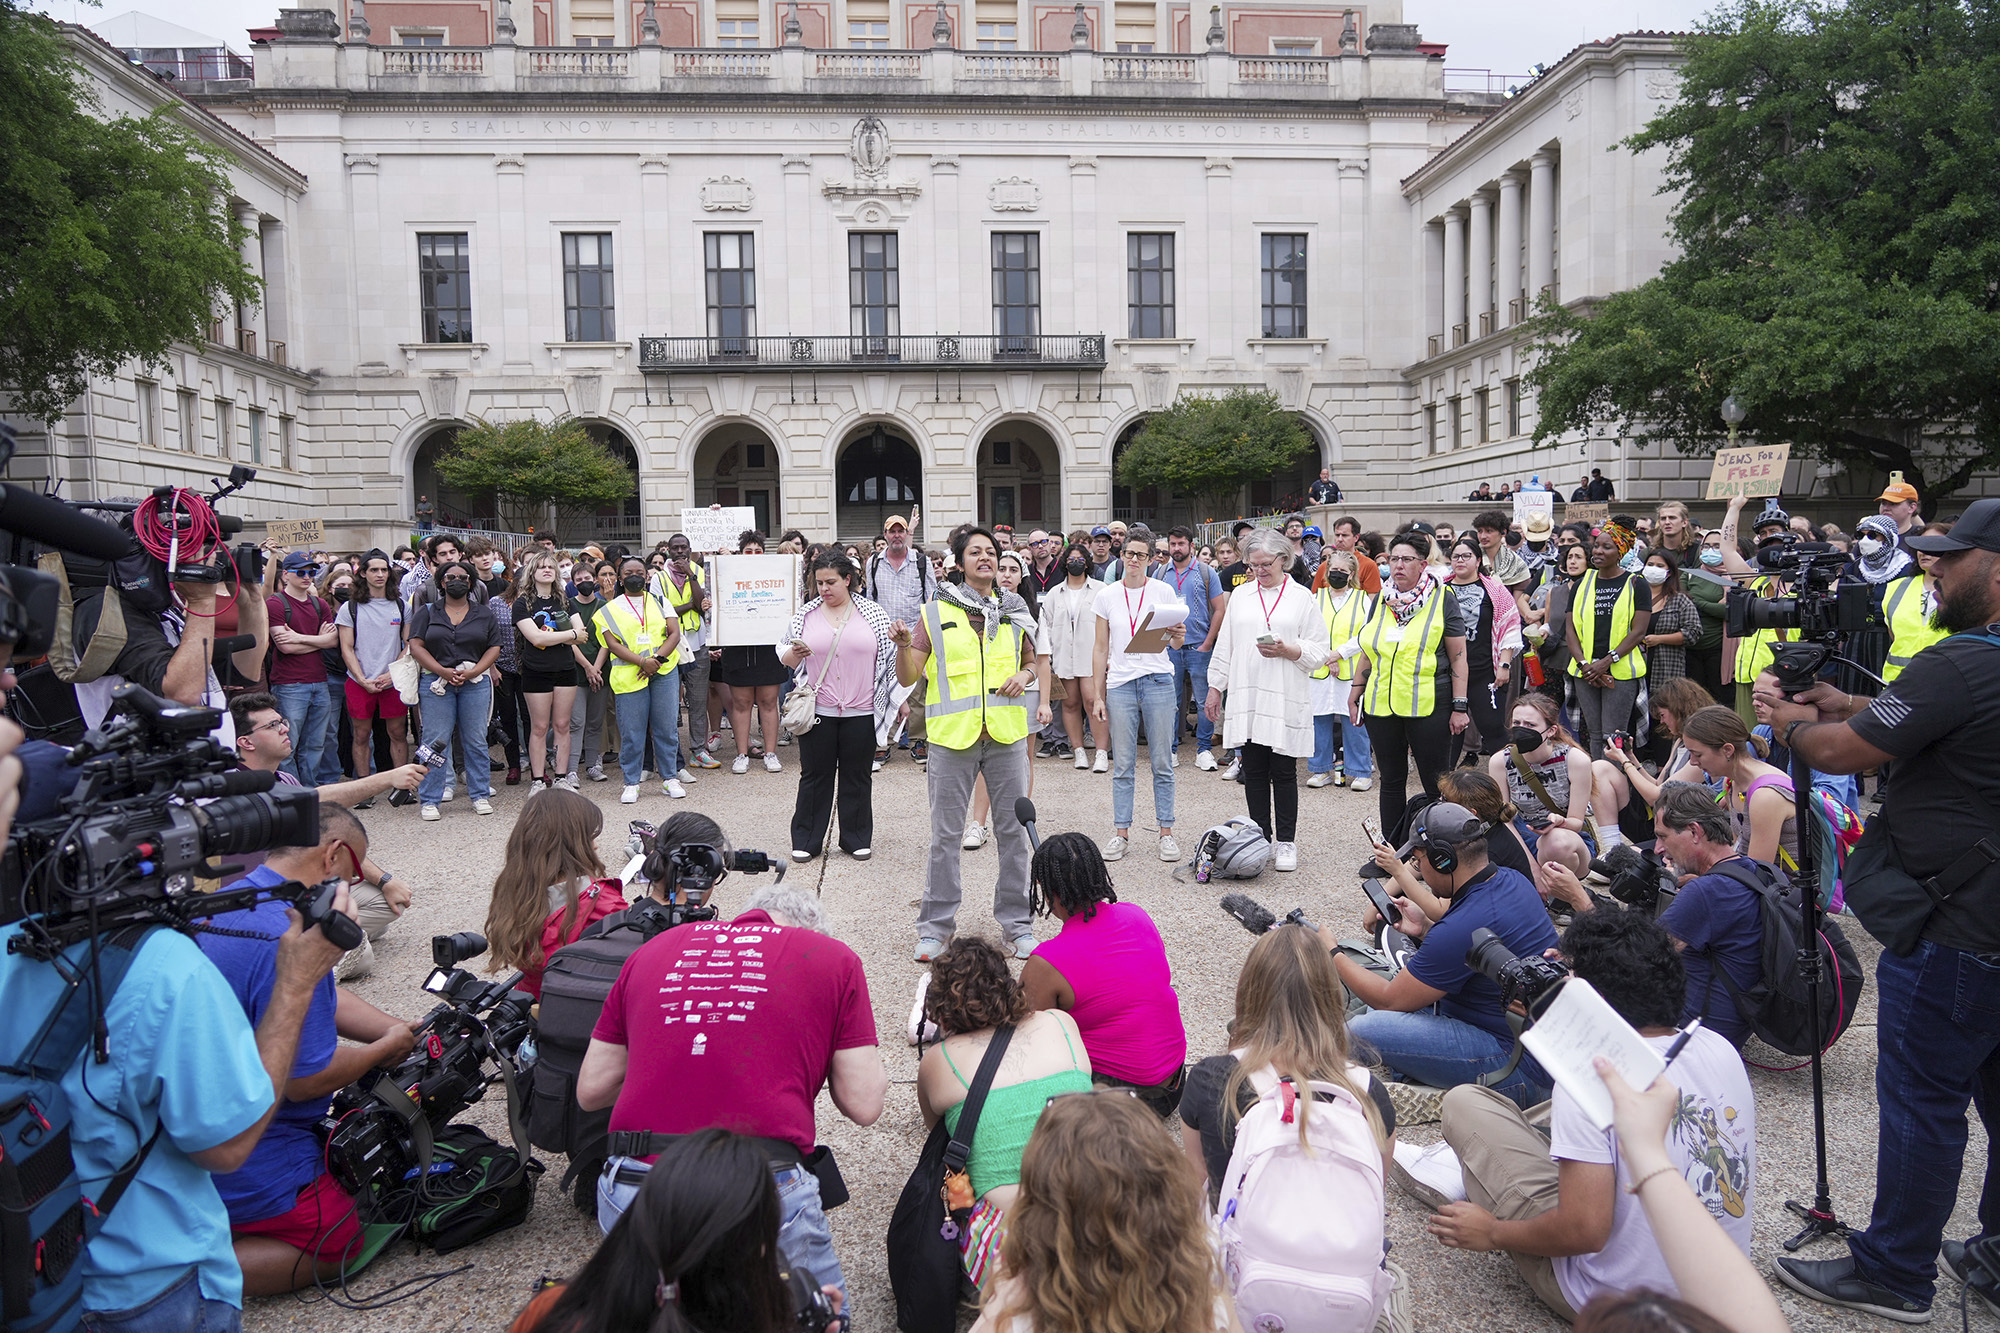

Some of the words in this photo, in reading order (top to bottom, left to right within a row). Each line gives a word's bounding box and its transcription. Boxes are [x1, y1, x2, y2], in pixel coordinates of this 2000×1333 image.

[405, 121, 431, 134] YE
[450, 121, 526, 134] SHALL
[543, 121, 612, 134] KNOW
[630, 121, 675, 134] THE
[693, 121, 773, 134] TRUTH
[792, 121, 841, 134] AND
[898, 122, 940, 135] THE
[956, 122, 1029, 136] TRUTH
[1047, 123, 1113, 136] SHALL
[1129, 124, 1186, 137] MAKE
[1201, 125, 1242, 138] YOU
[1259, 126, 1310, 139] FREE
[1718, 453, 1753, 466] JEWS
[1758, 451, 1774, 460] FOR
[1777, 452, 1783, 460] A
[1728, 464, 1771, 480] FREE
[1714, 478, 1781, 497] PALESTINE
[1519, 495, 1545, 505] VIVA
[684, 509, 734, 517] UNIVERSITIES
[1568, 509, 1608, 519] PALESTINE
[685, 517, 723, 525] INVESTING
[270, 524, 288, 532] THIS
[290, 523, 297, 531] IS
[300, 521, 318, 530] NOT
[685, 526, 724, 534] WEAPONS
[278, 533, 290, 543] MY
[292, 532, 319, 542] TEXAS
[689, 534, 704, 542] IKE
[735, 581, 752, 590] THE
[754, 579, 785, 589] SYSTEM
[206, 901, 230, 909] SONY
[695, 924, 782, 934] VOLUNTEER
